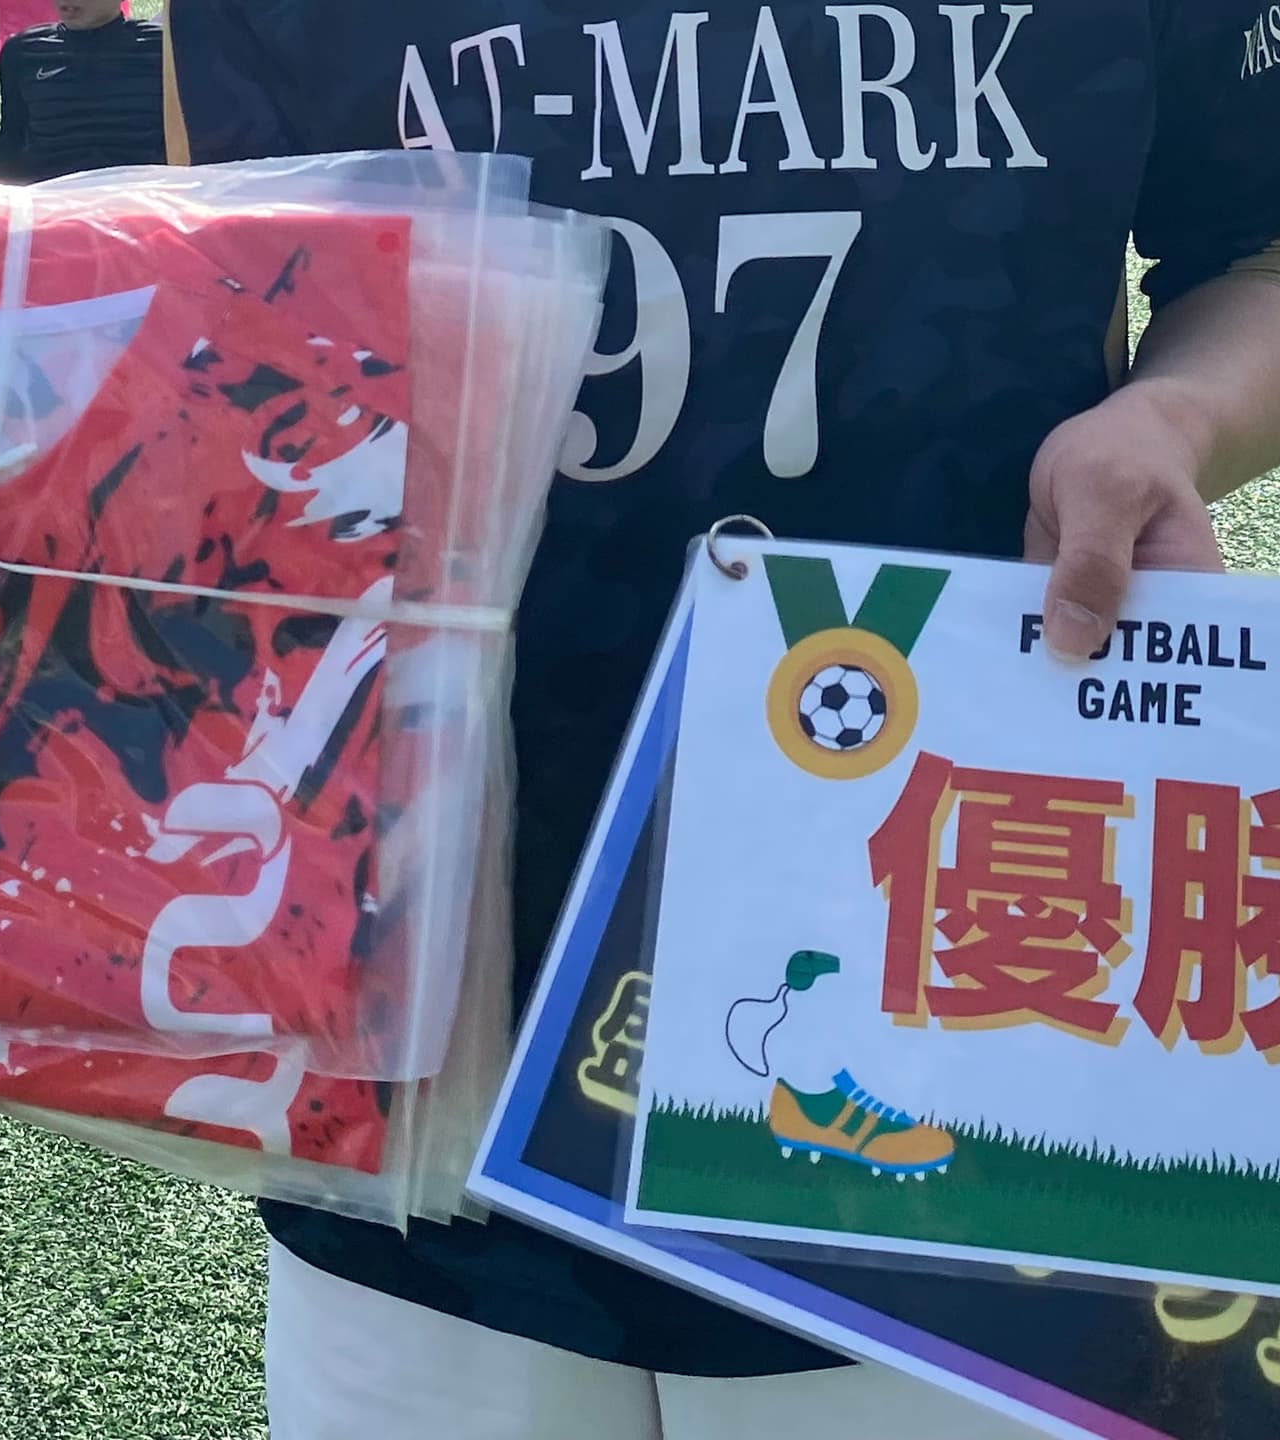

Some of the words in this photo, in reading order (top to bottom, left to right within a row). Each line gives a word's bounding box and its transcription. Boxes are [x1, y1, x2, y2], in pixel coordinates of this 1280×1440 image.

[397, 3, 1048, 181] AT-MARK
[558, 210, 862, 483] 97
[1019, 613, 1267, 671] FTBALL
[1077, 677, 1202, 727] GAME
